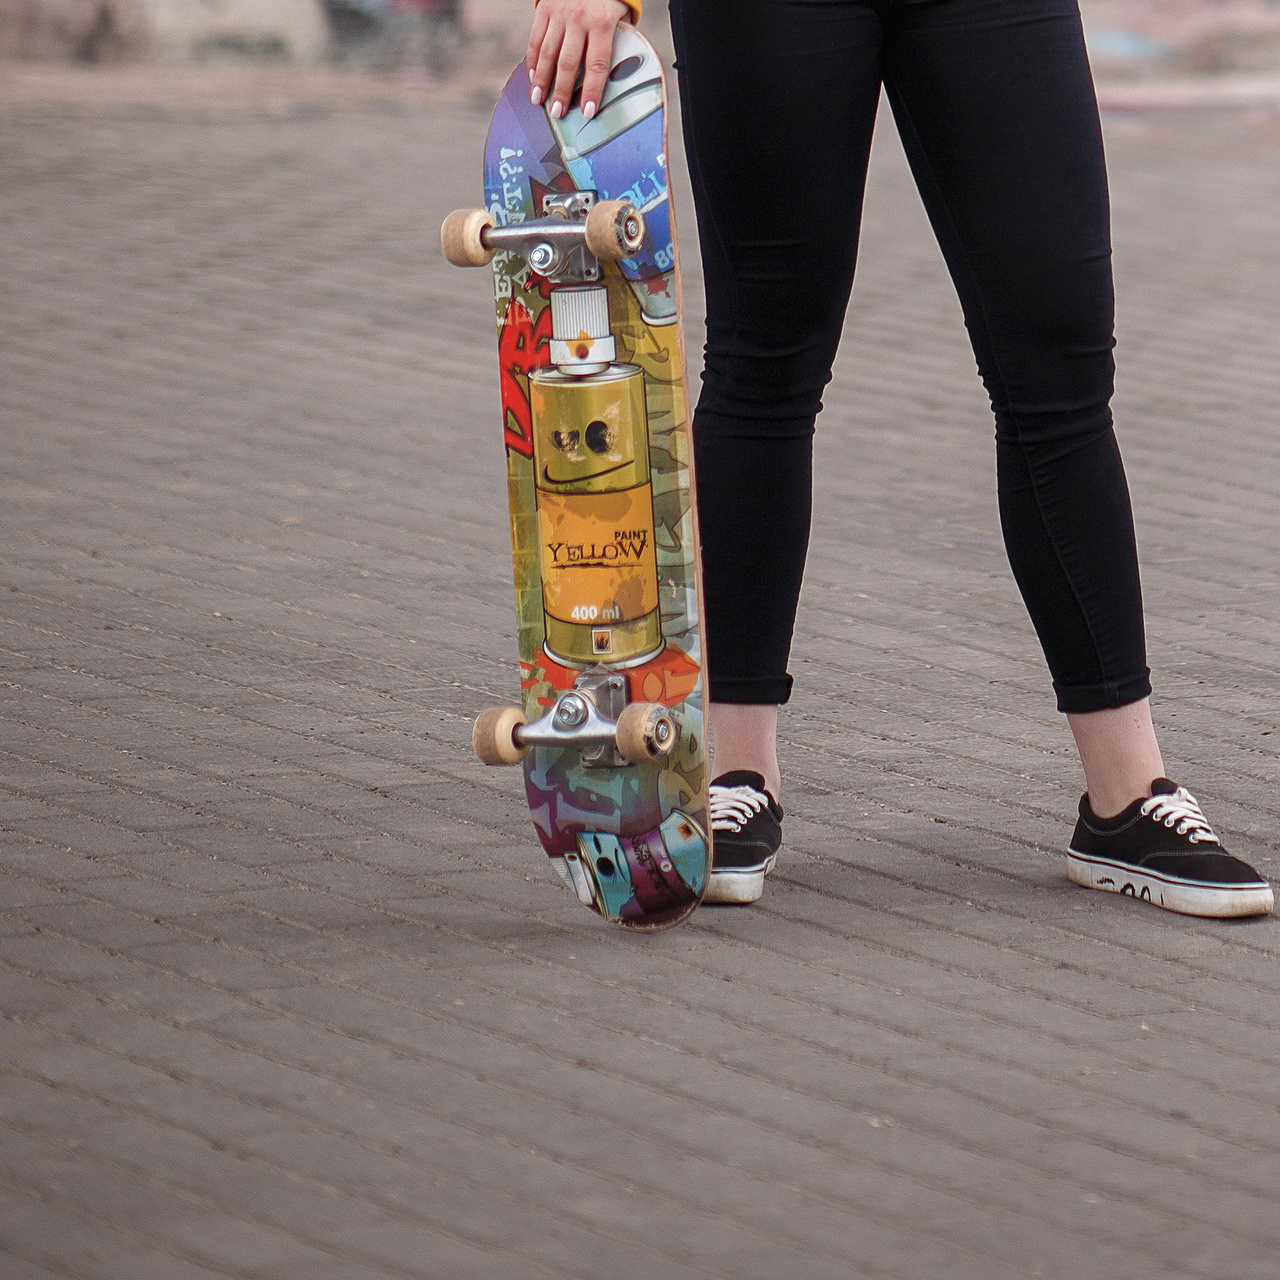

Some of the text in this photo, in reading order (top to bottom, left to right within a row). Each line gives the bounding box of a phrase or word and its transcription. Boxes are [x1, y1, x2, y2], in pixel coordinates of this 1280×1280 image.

[614, 529, 648, 540] PAINT
[571, 605, 620, 620] 400 ml
